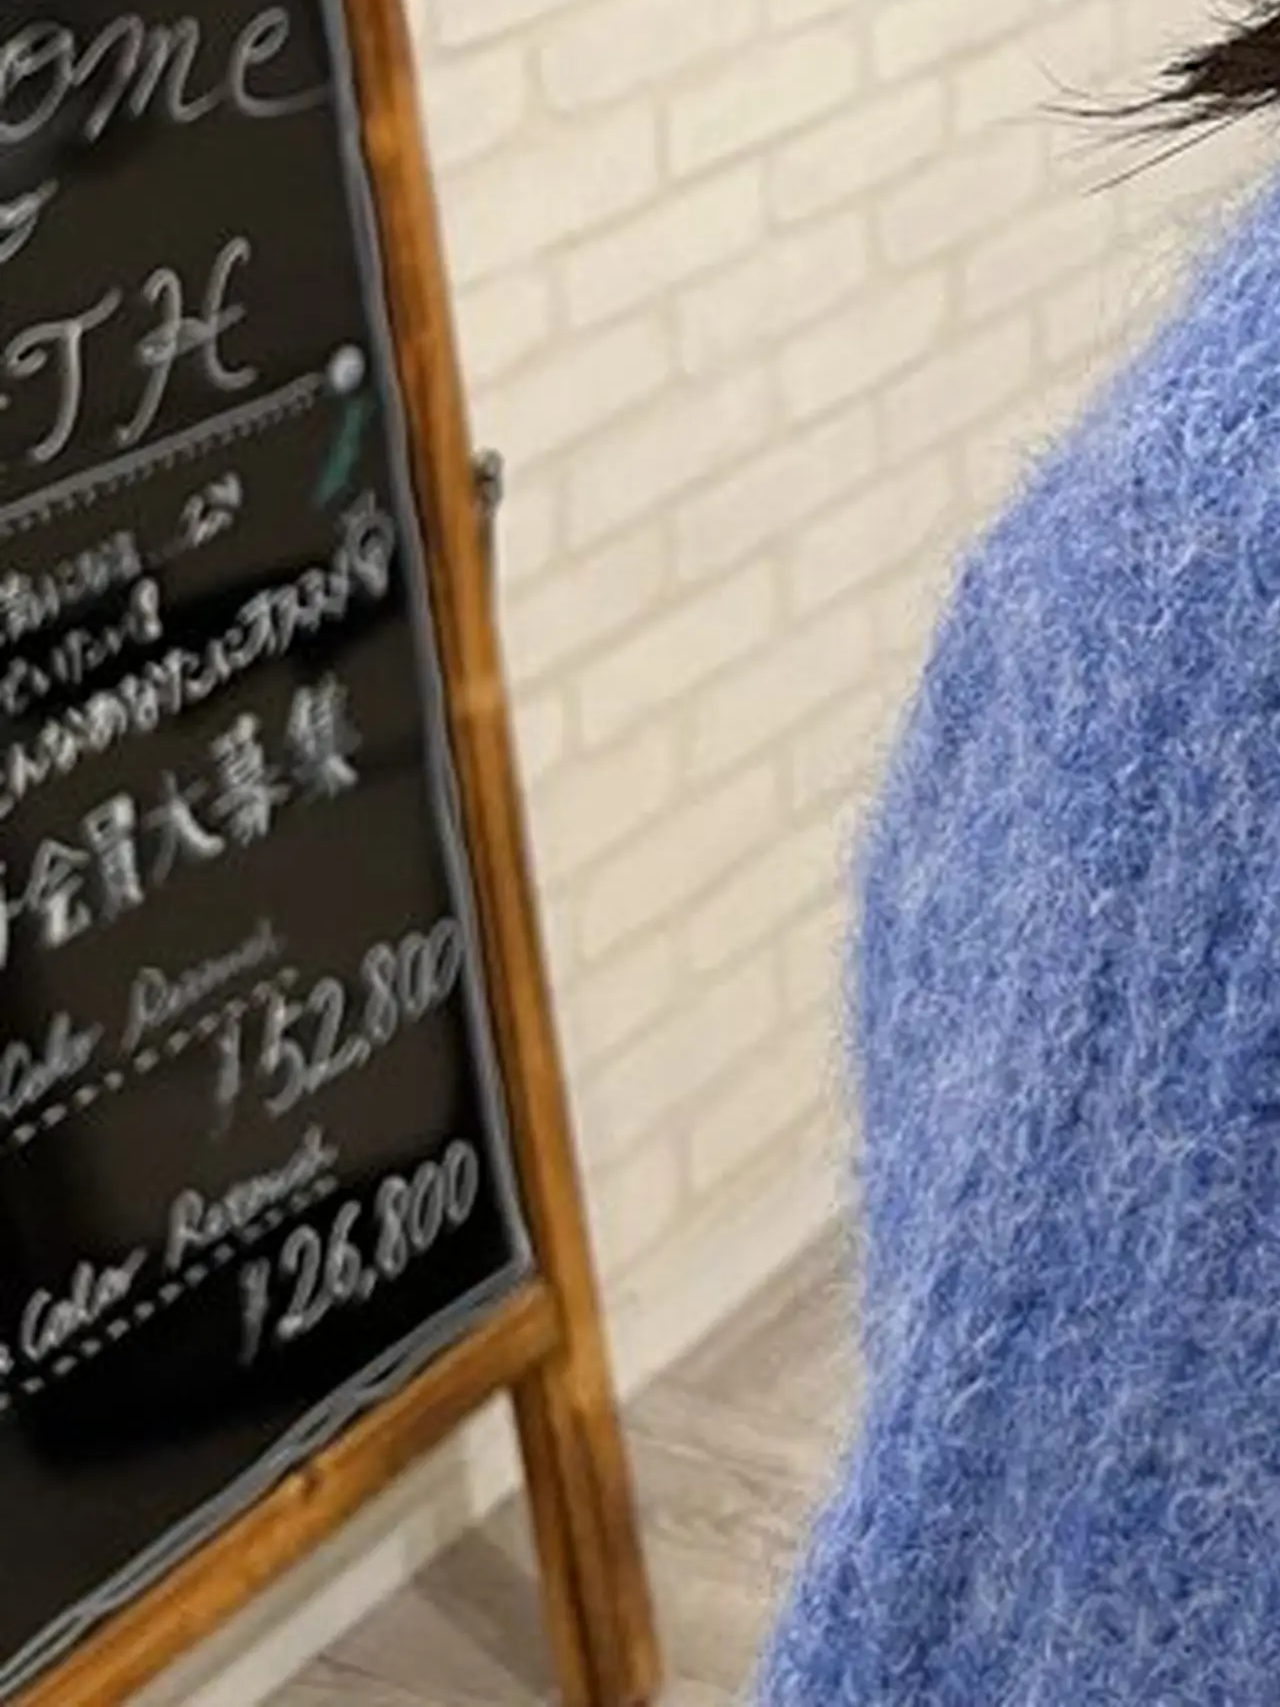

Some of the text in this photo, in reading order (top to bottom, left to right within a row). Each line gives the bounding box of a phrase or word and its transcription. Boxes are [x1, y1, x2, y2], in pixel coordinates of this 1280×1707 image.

[0, 671, 362, 969] 会員大募集
